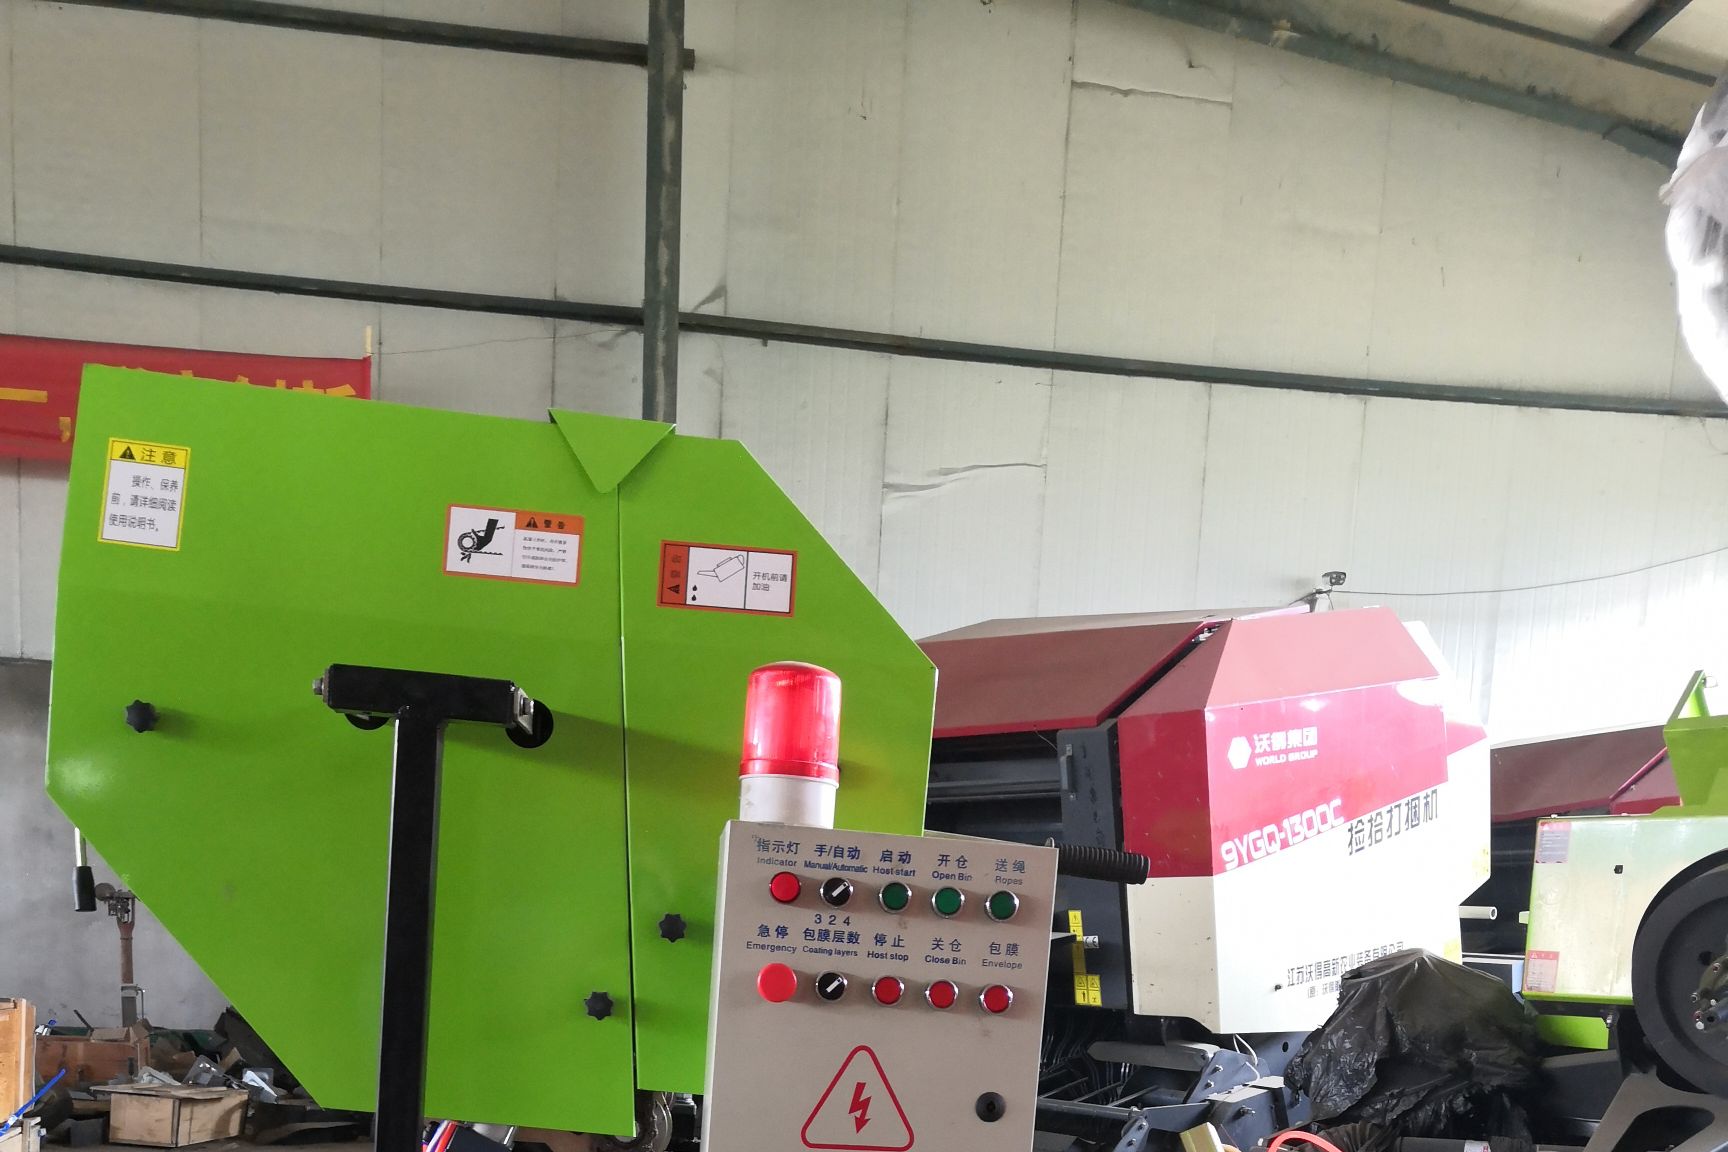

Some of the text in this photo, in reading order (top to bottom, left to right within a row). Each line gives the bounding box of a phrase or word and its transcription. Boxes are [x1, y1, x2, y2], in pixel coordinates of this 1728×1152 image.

[141, 448, 177, 465] 注意
[752, 571, 788, 583] 开机前请
[752, 582, 770, 591] 加油
[1255, 753, 1287, 767] WORLD
[1220, 797, 1345, 872] 9YGQ-1300C
[756, 839, 801, 855] 指示灯
[813, 844, 861, 860] 手/自动
[757, 857, 798, 867] Indicator
[880, 850, 912, 864] 启动
[937, 854, 969, 869] 开仓
[804, 860, 868, 873] Manual/Automatic
[872, 866, 916, 877] Host start
[995, 858, 1025, 874] 送绳
[931, 870, 973, 882] Open Bin
[995, 875, 1023, 886] Ropes
[814, 914, 851, 926] 3 2 4
[757, 924, 789, 939] 急停
[803, 928, 860, 945] 包膜层数
[874, 933, 905, 948] 停止
[932, 938, 962, 953] 关仓
[746, 941, 797, 954] Emergency
[802, 945, 858, 957] Coating layers
[989, 942, 1020, 957] 包膜
[867, 951, 909, 962] Host stop
[925, 954, 966, 965] Close Bin
[982, 958, 1023, 970] Envelope
